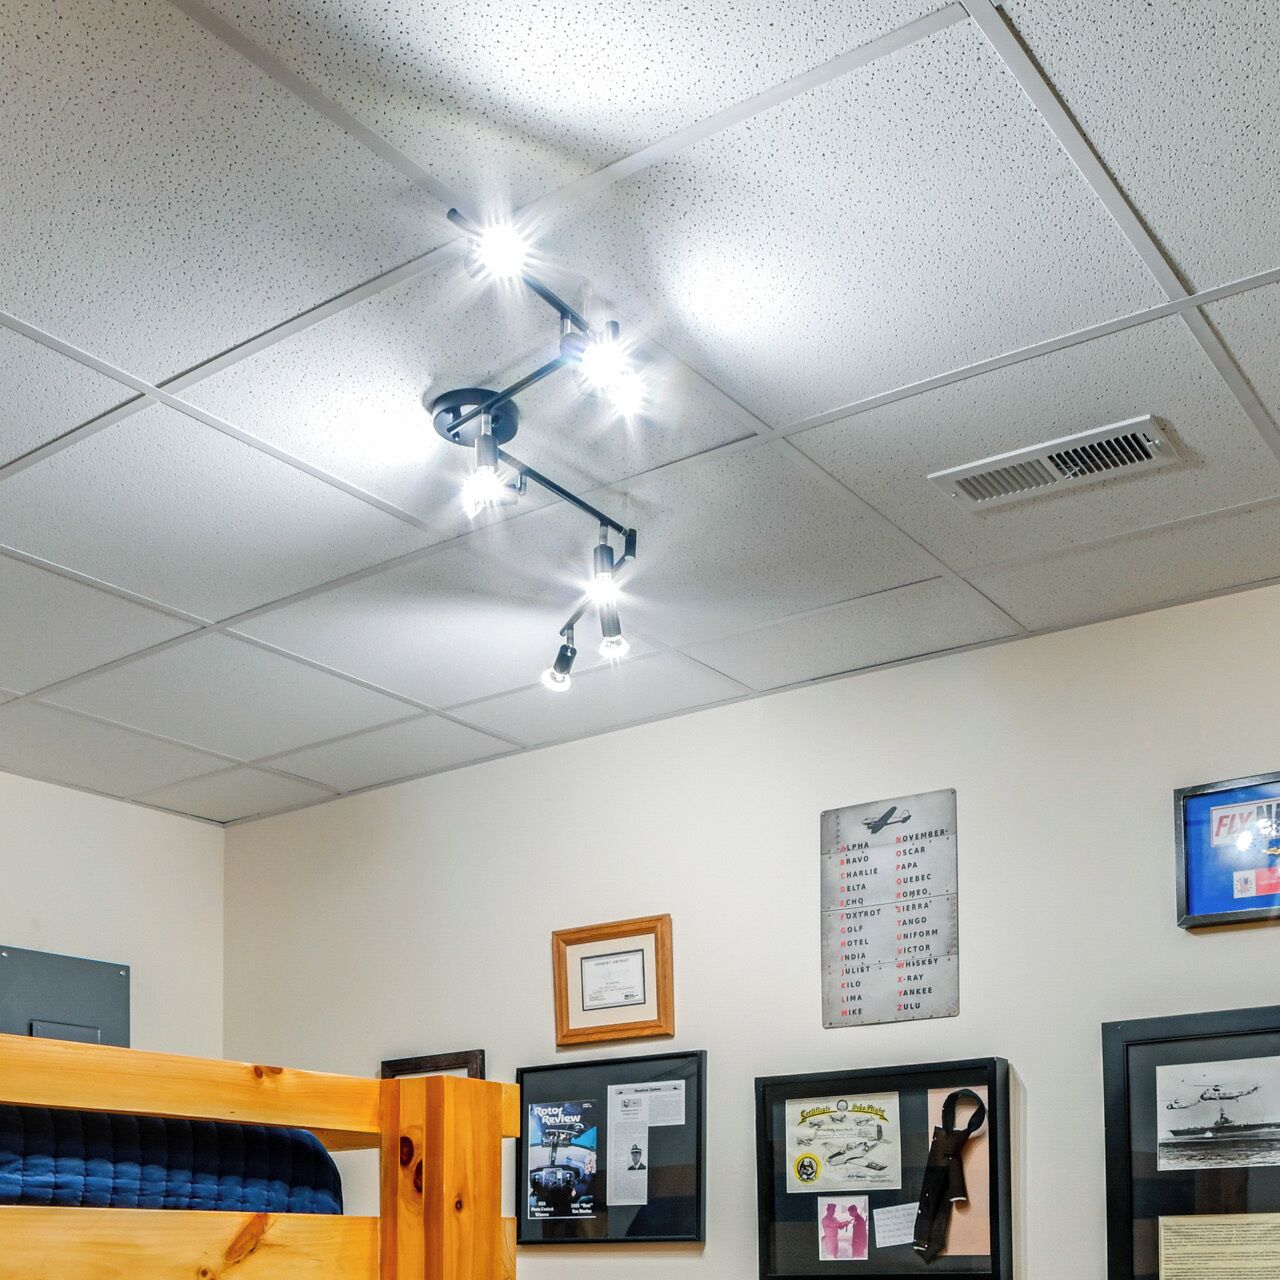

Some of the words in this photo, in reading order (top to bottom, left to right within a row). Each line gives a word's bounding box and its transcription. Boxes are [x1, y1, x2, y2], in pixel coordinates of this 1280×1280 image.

[1215, 811, 1254, 837] FLY
[896, 829, 945, 844] NOVEMBER
[839, 841, 870, 853] ALPHA
[896, 846, 926, 857] OSCAR
[839, 855, 869, 866] BRAVO
[896, 861, 918, 871] PAPA
[840, 868, 878, 879] CHARLIE
[896, 873, 932, 885] QUEBEC
[840, 883, 866, 893] DELTA
[896, 888, 928, 898] ROMEO
[840, 897, 864, 907] ECHO
[895, 902, 929, 913] SIERRA
[840, 908, 881, 920] FOXTROT
[896, 916, 927, 927] TANGO
[840, 925, 863, 934] GOLF
[896, 929, 938, 940] UNIFORM
[840, 938, 869, 948] HOTEL
[897, 944, 931, 954] VICTOR
[840, 952, 866, 961] INDIA
[896, 958, 938, 968] WHISKEY
[840, 966, 870, 976] JULIET
[897, 974, 924, 983] X-RAY
[840, 981, 861, 989] KILO
[897, 987, 933, 997] YANKEE
[841, 994, 863, 1003] LIMA
[897, 1002, 921, 1011] ZULU
[841, 1008, 863, 1016] MIKE
[535, 1106, 563, 1117] Rotor
[542, 1115, 581, 1125] Review
